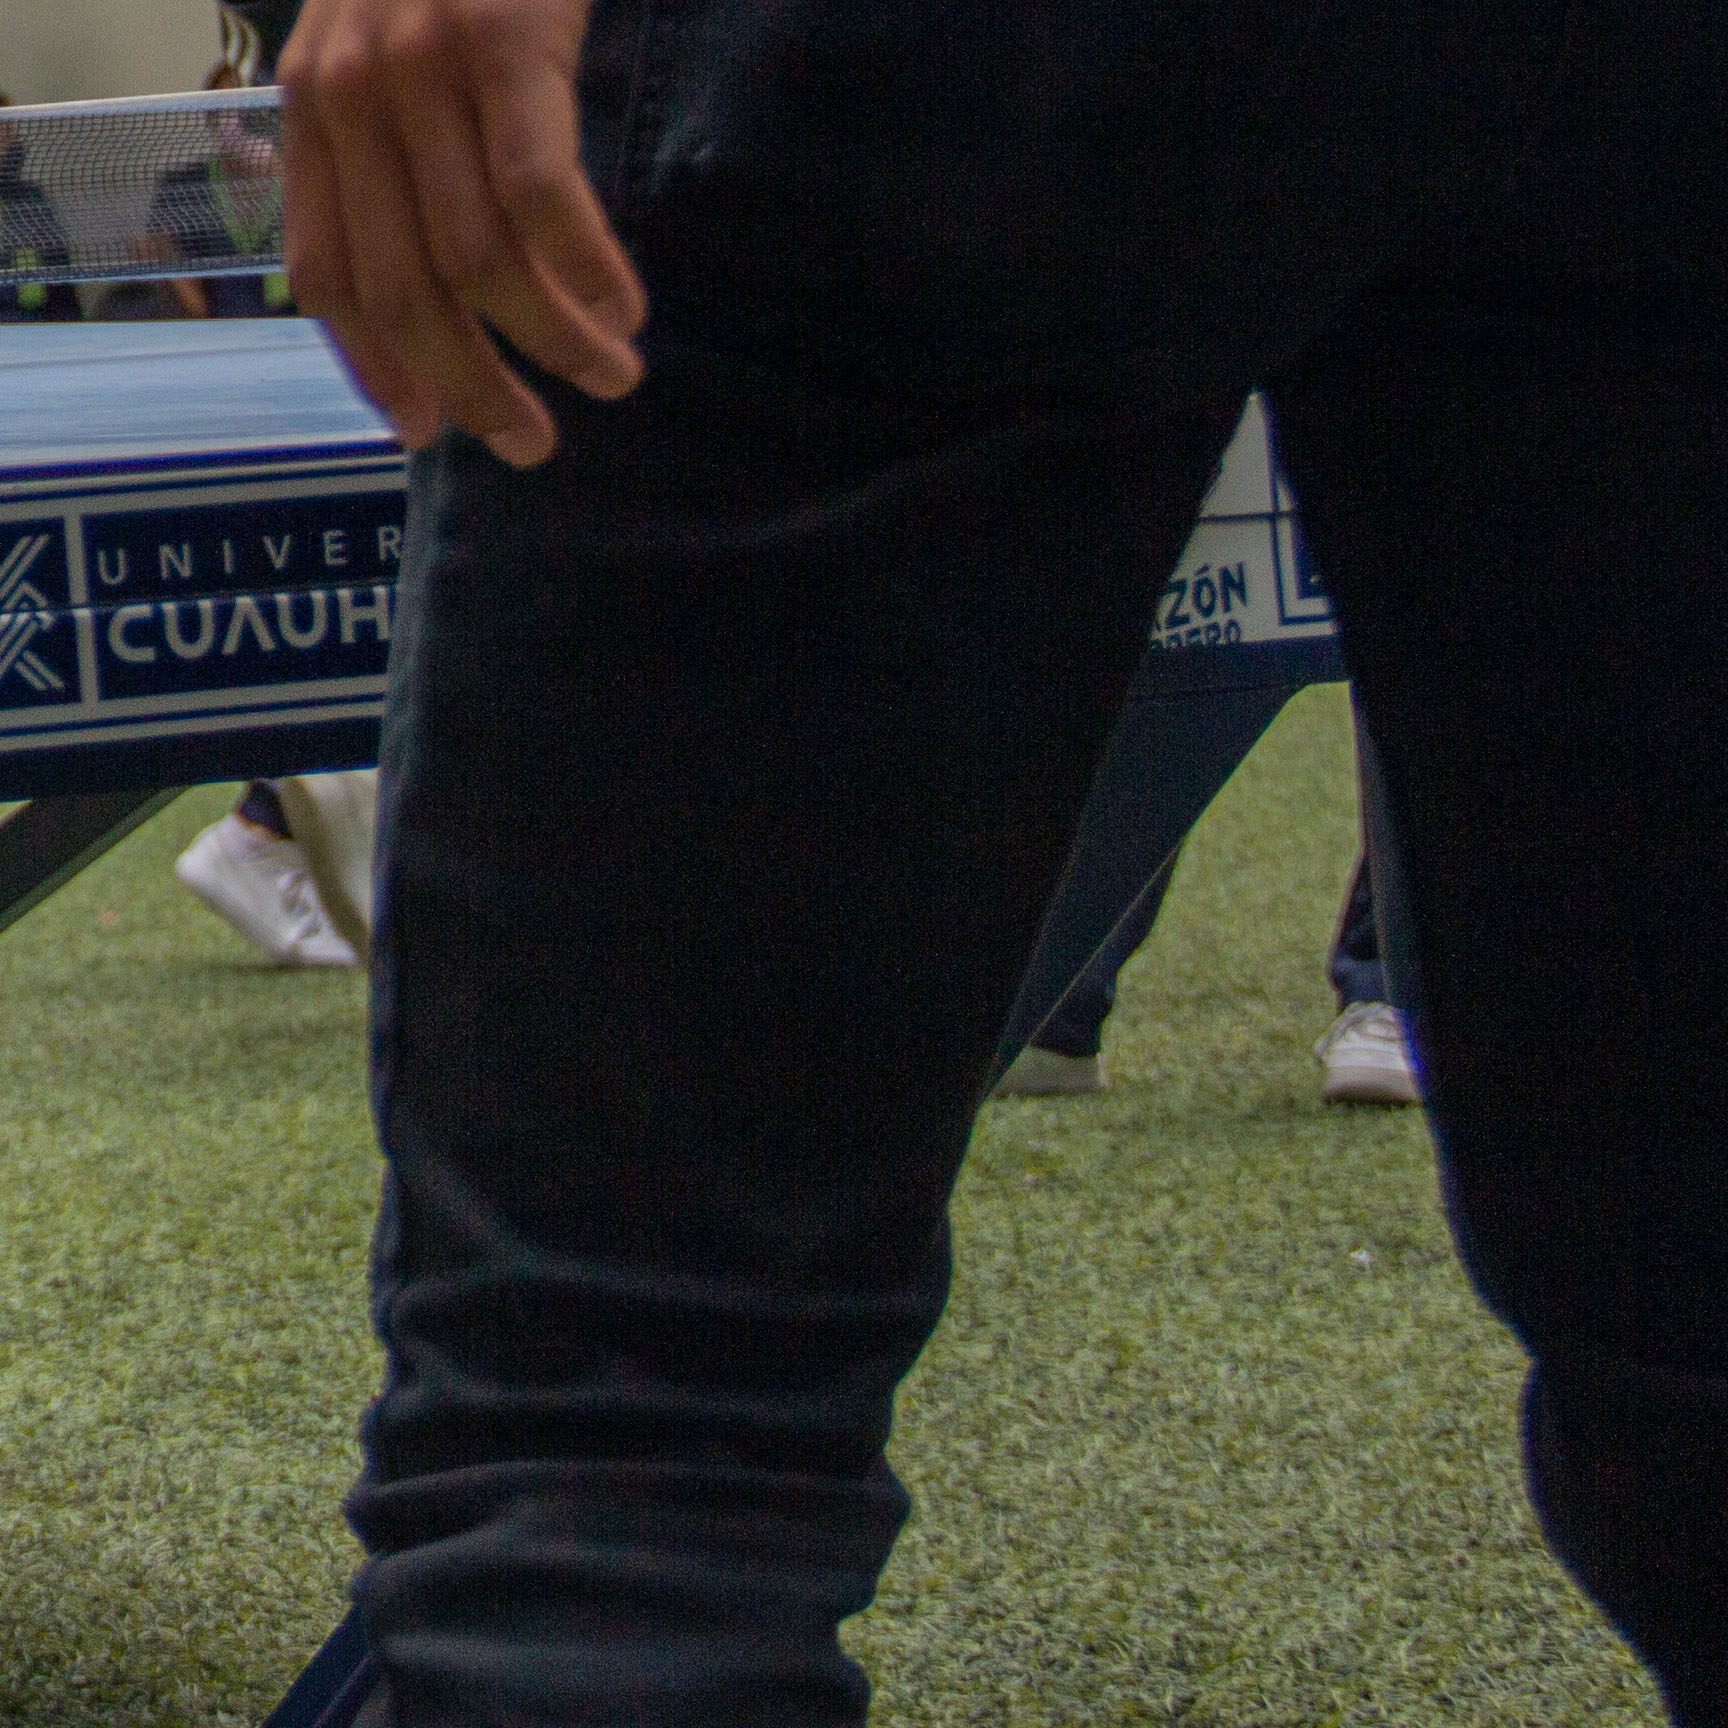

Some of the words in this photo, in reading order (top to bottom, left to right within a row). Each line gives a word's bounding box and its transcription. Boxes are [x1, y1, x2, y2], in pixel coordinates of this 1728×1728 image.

[97, 526, 402, 585] UNIVER
[107, 585, 390, 663] CUAUH
[1156, 561, 1247, 630] ZÓN
